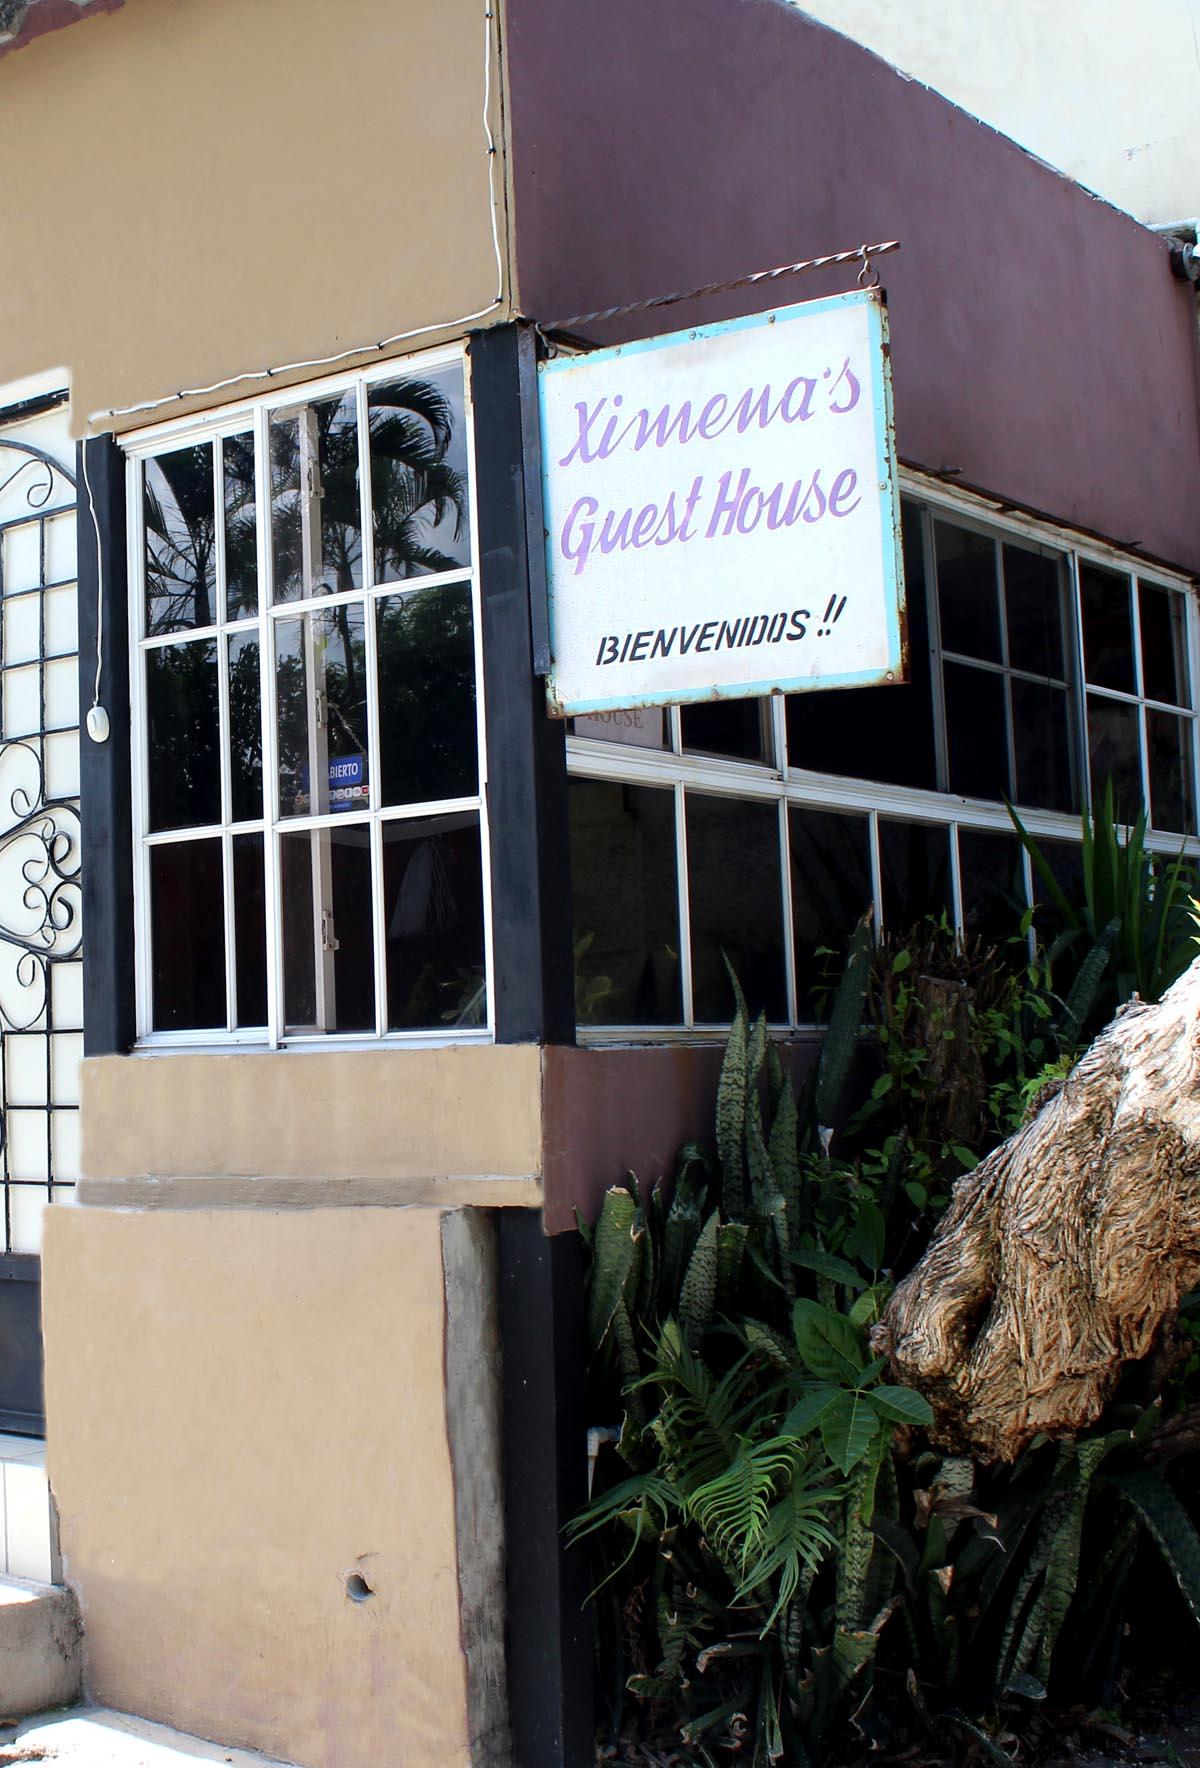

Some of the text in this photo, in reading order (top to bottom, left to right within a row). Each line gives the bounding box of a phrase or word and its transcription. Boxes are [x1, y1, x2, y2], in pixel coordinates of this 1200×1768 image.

[559, 357, 860, 466] Ximena's
[561, 468, 862, 575] Guest House
[328, 762, 359, 779] BIERTO
